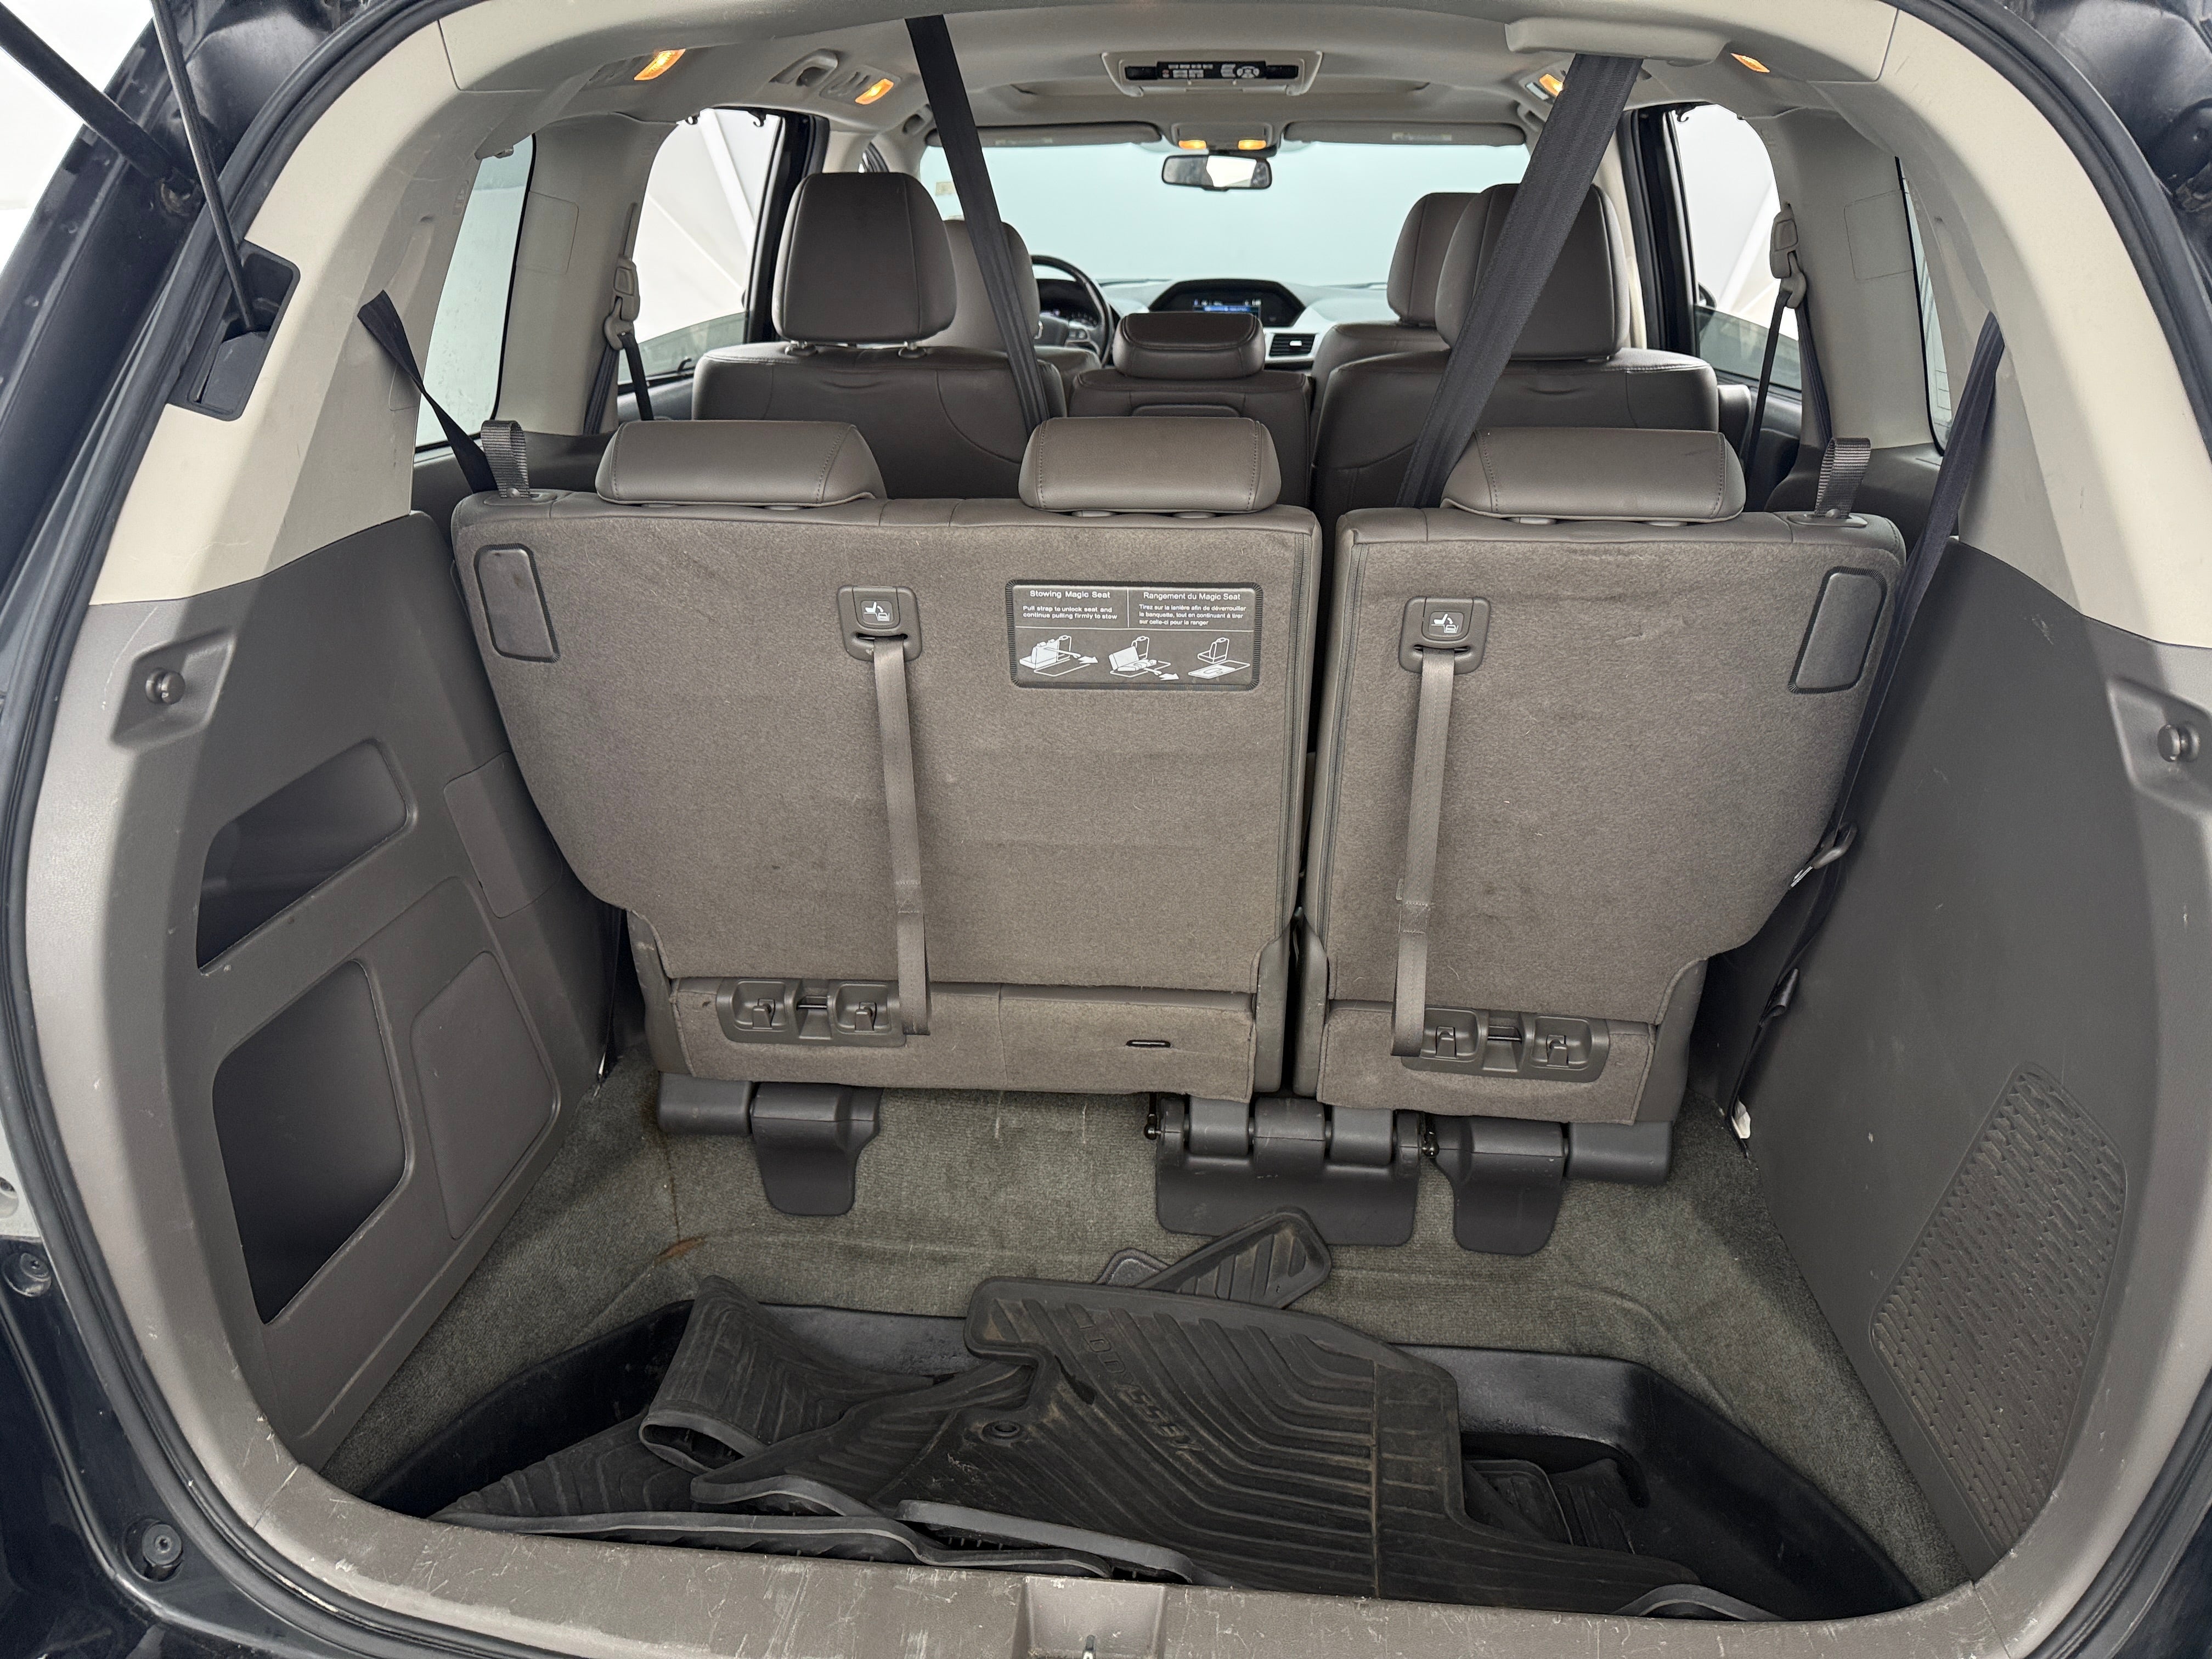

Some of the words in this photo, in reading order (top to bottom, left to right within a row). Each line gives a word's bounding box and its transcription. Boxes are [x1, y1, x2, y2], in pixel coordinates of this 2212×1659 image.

[1030, 590, 1062, 599] Stowing
[1065, 591, 1089, 599] Magic
[1143, 592, 1186, 601] Rangement
[1199, 593, 1221, 601] Magic
